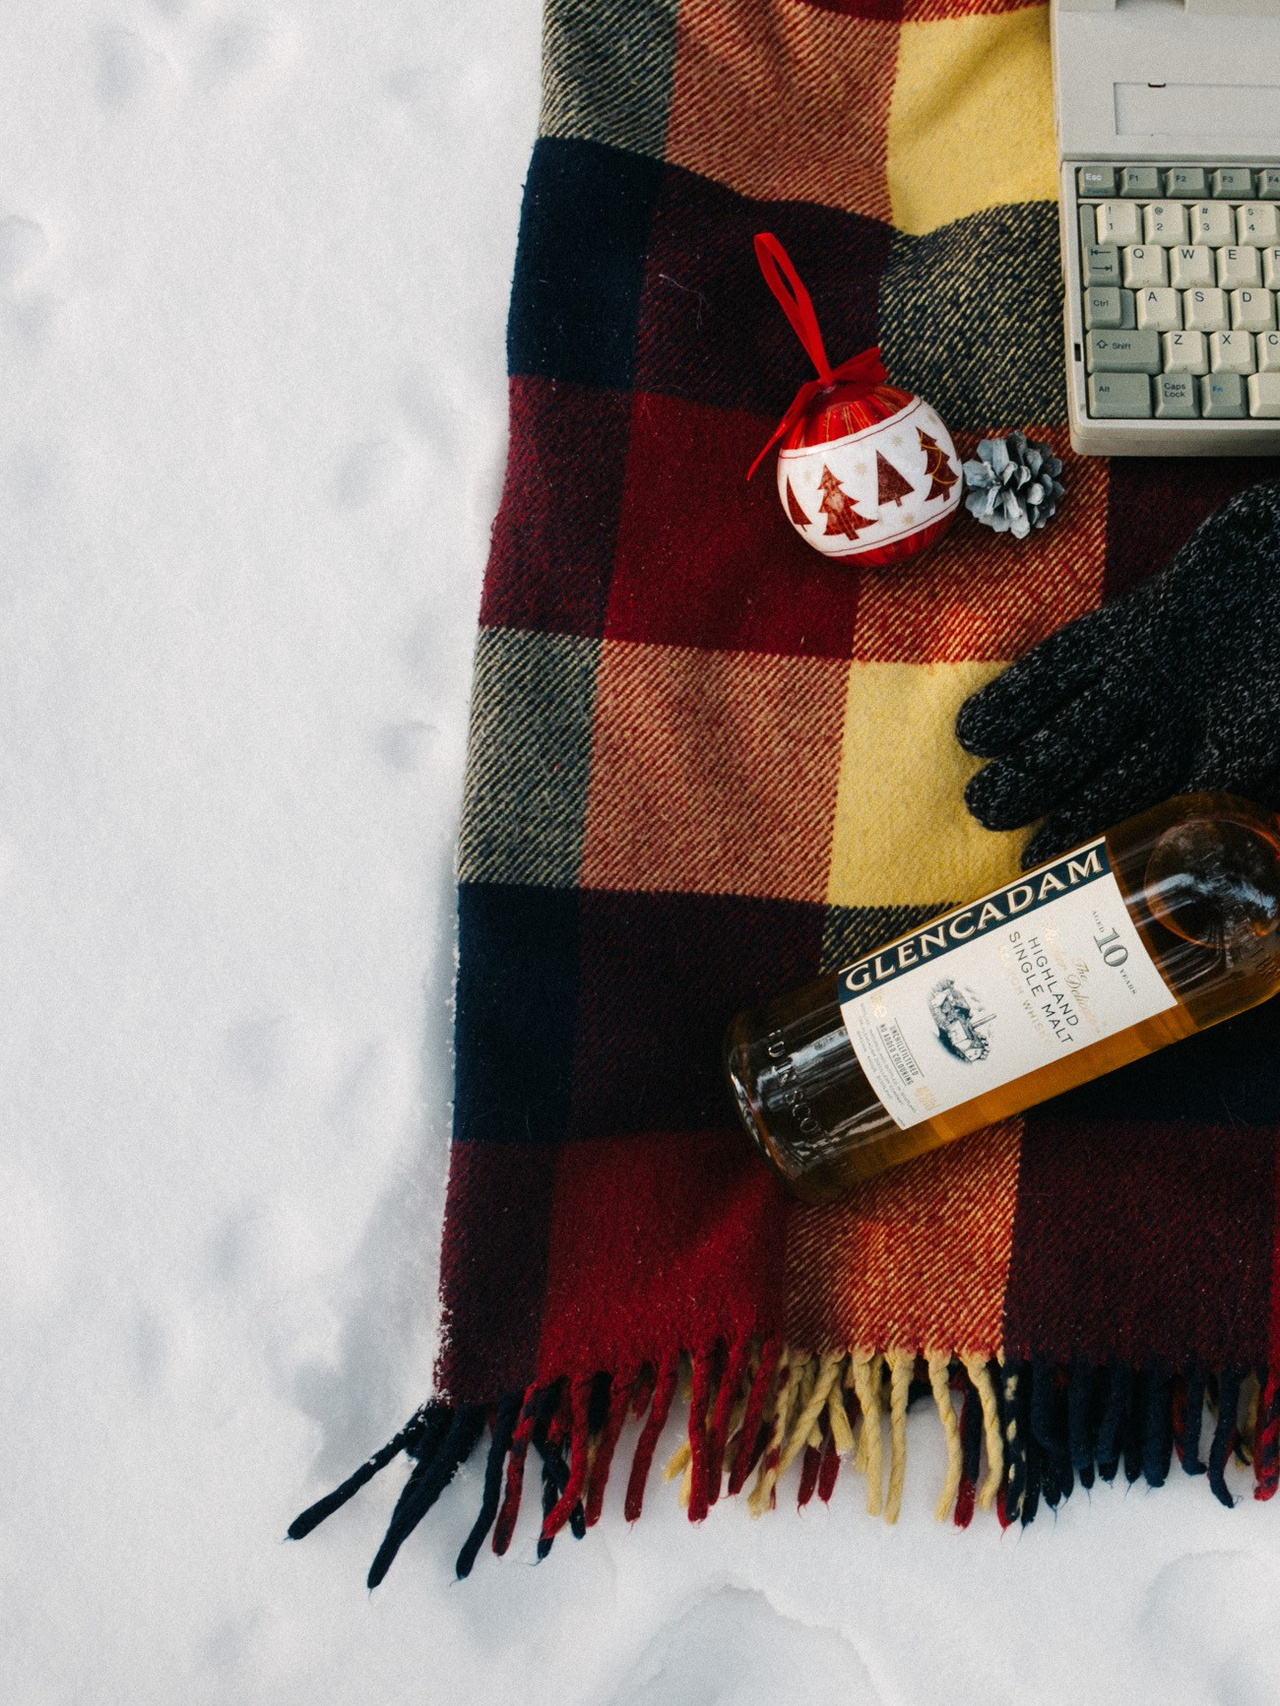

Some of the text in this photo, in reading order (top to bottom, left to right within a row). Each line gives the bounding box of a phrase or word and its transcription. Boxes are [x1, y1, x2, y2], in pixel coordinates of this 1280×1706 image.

[1085, 173, 1102, 181] Esc
[1133, 248, 1145, 259] Q
[1180, 248, 1196, 260] W
[1228, 249, 1238, 260] E
[1148, 292, 1158, 302] A
[1194, 291, 1205, 302] S
[1242, 292, 1252, 302] D
[1092, 300, 1110, 308] Ctrl
[1174, 334, 1184, 345] Z
[1222, 334, 1232, 345] X
[1268, 334, 1279, 346] C
[1112, 342, 1132, 350] Shift
[1098, 385, 1110, 393] Alt
[1164, 382, 1186, 392] Caps
[1164, 390, 1186, 398] Lock
[845, 849, 1104, 992] GLENCADAM
[1092, 910, 1136, 995] AGED 10 YEARS
[1028, 936, 1080, 1026] HIGHLAND
[1009, 931, 1045, 998] SINGLE
[1041, 1004, 1074, 1044] MALT
[890, 1025, 919, 1076] UNCHILLFILTERED
[884, 1032, 897, 1054] ADDED
[892, 1052, 914, 1086] COLOURING
